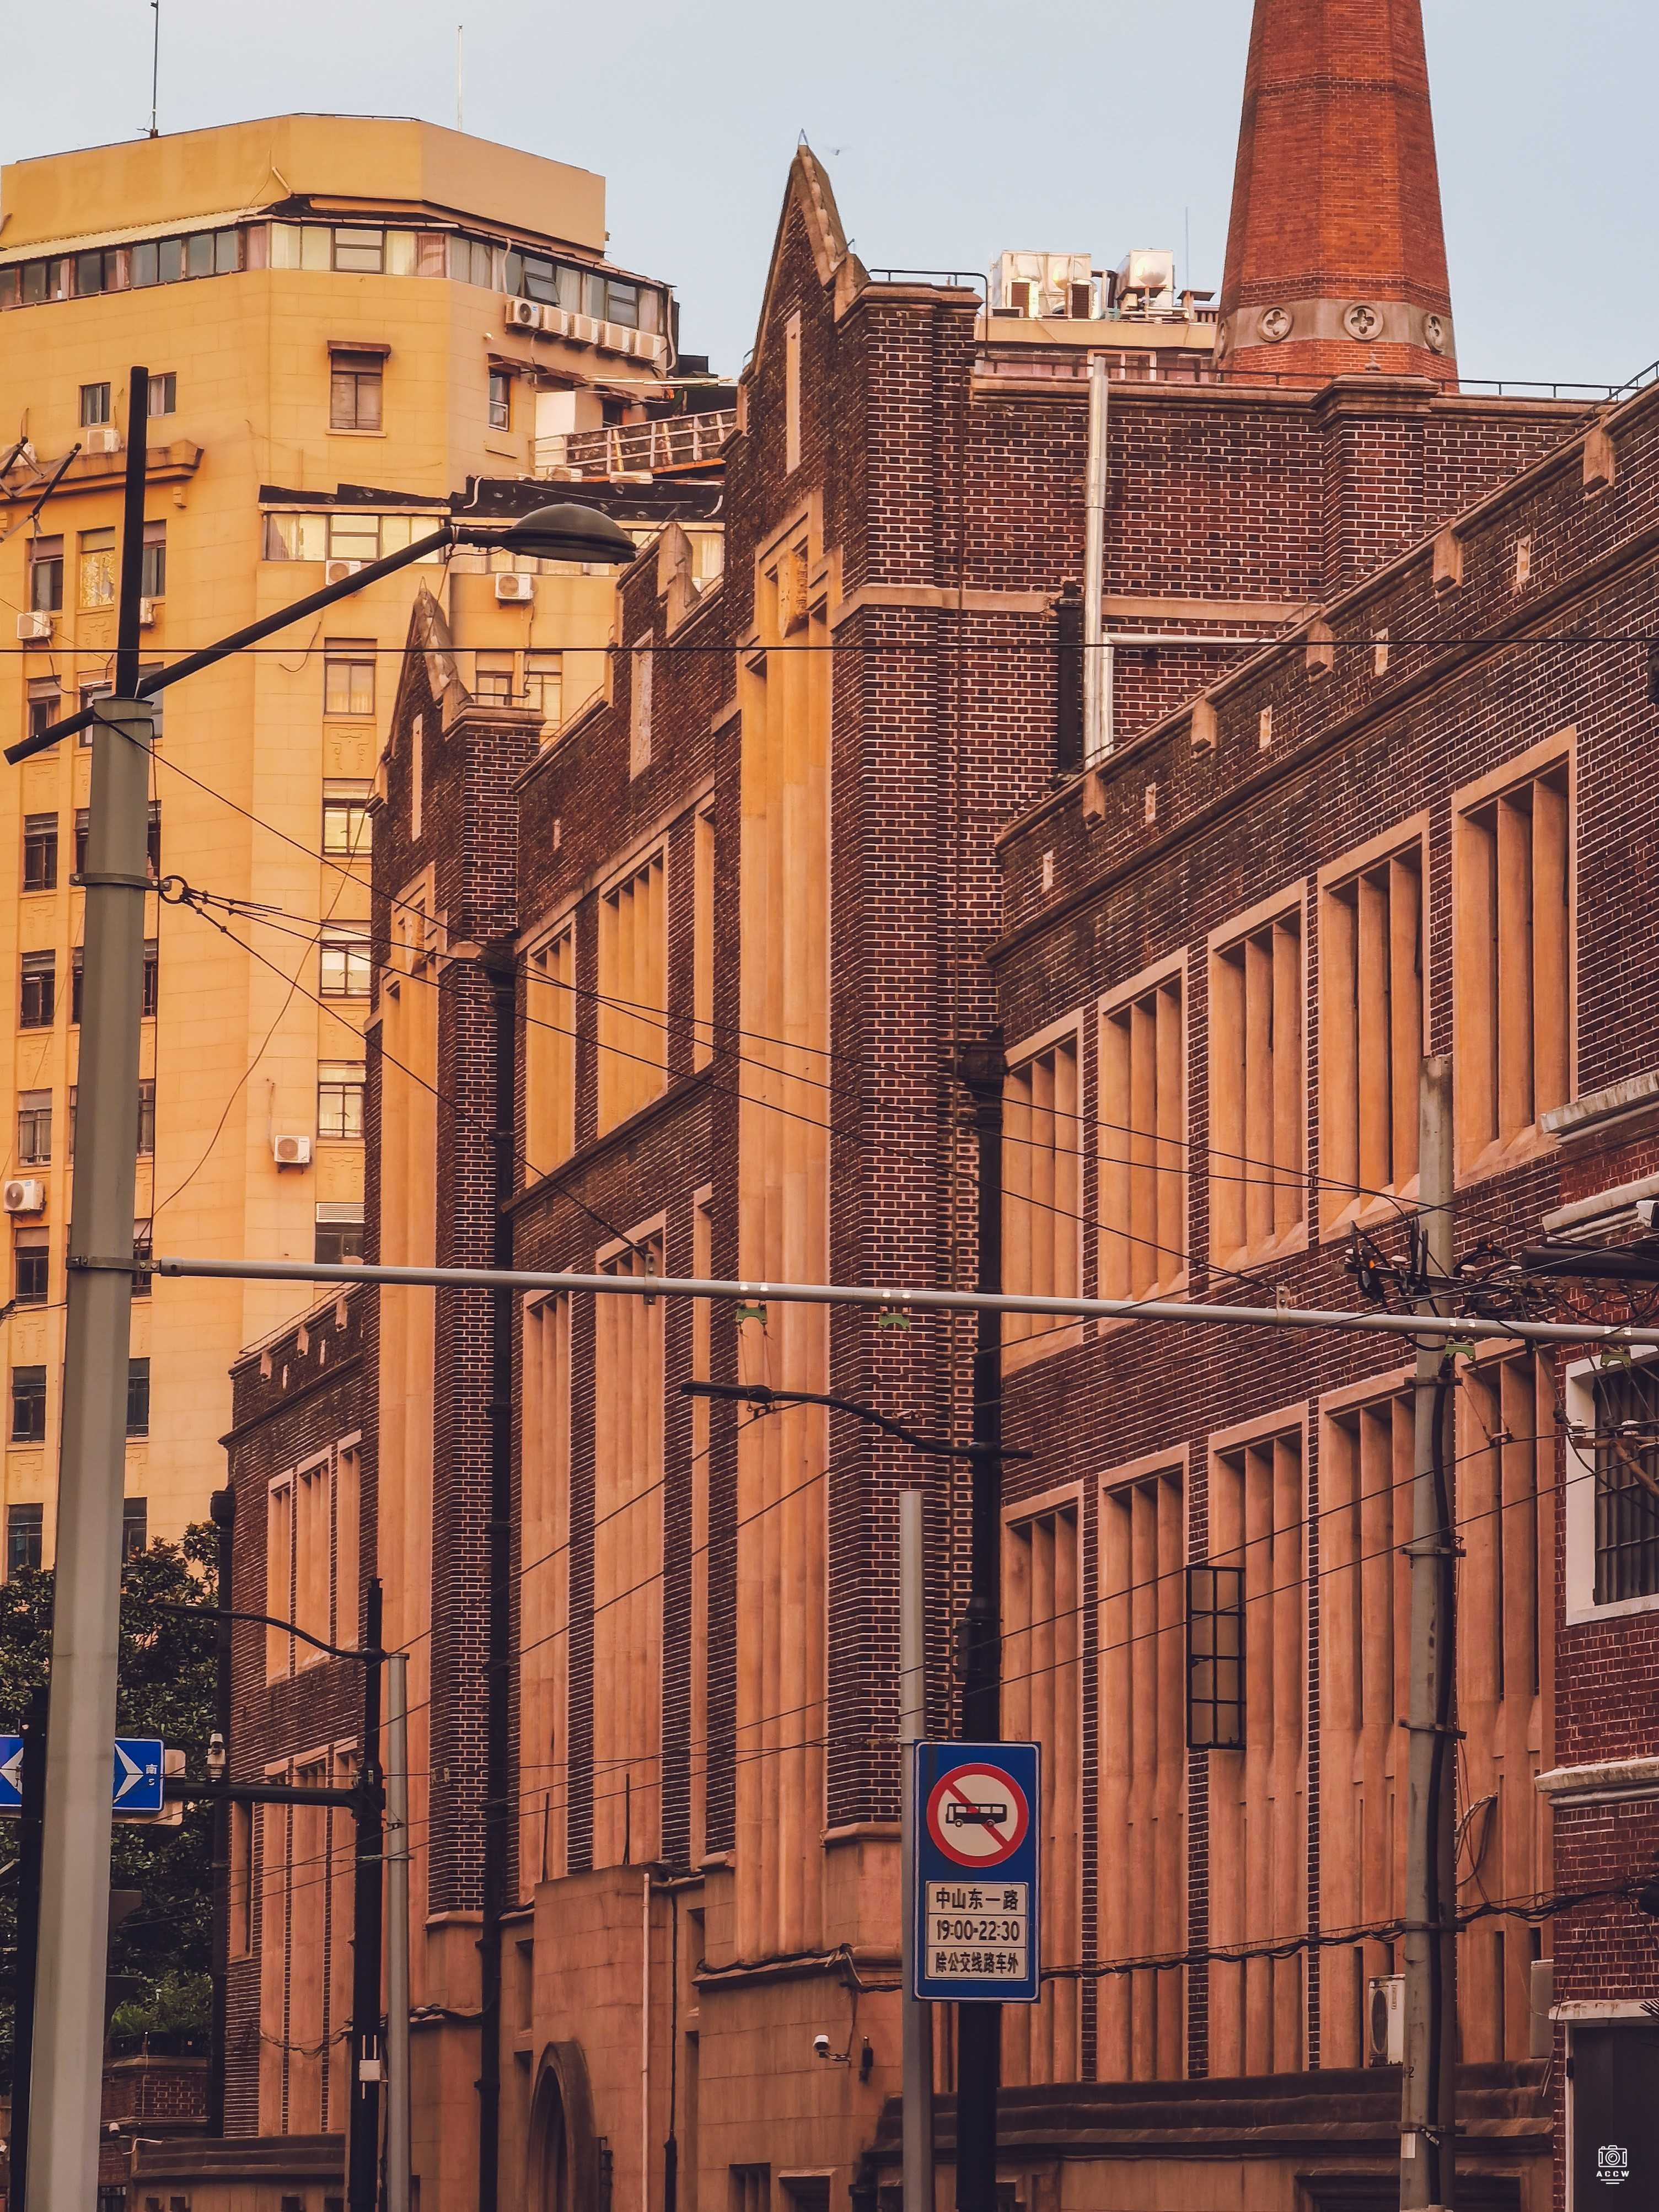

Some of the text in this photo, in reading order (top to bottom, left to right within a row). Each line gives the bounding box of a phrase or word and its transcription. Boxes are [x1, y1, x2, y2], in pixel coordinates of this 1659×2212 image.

[936, 1887, 1018, 1911] 中山东一路
[937, 1920, 1020, 1941] 19:00-22:30
[936, 1952, 1019, 1974] 除公交线路车外
